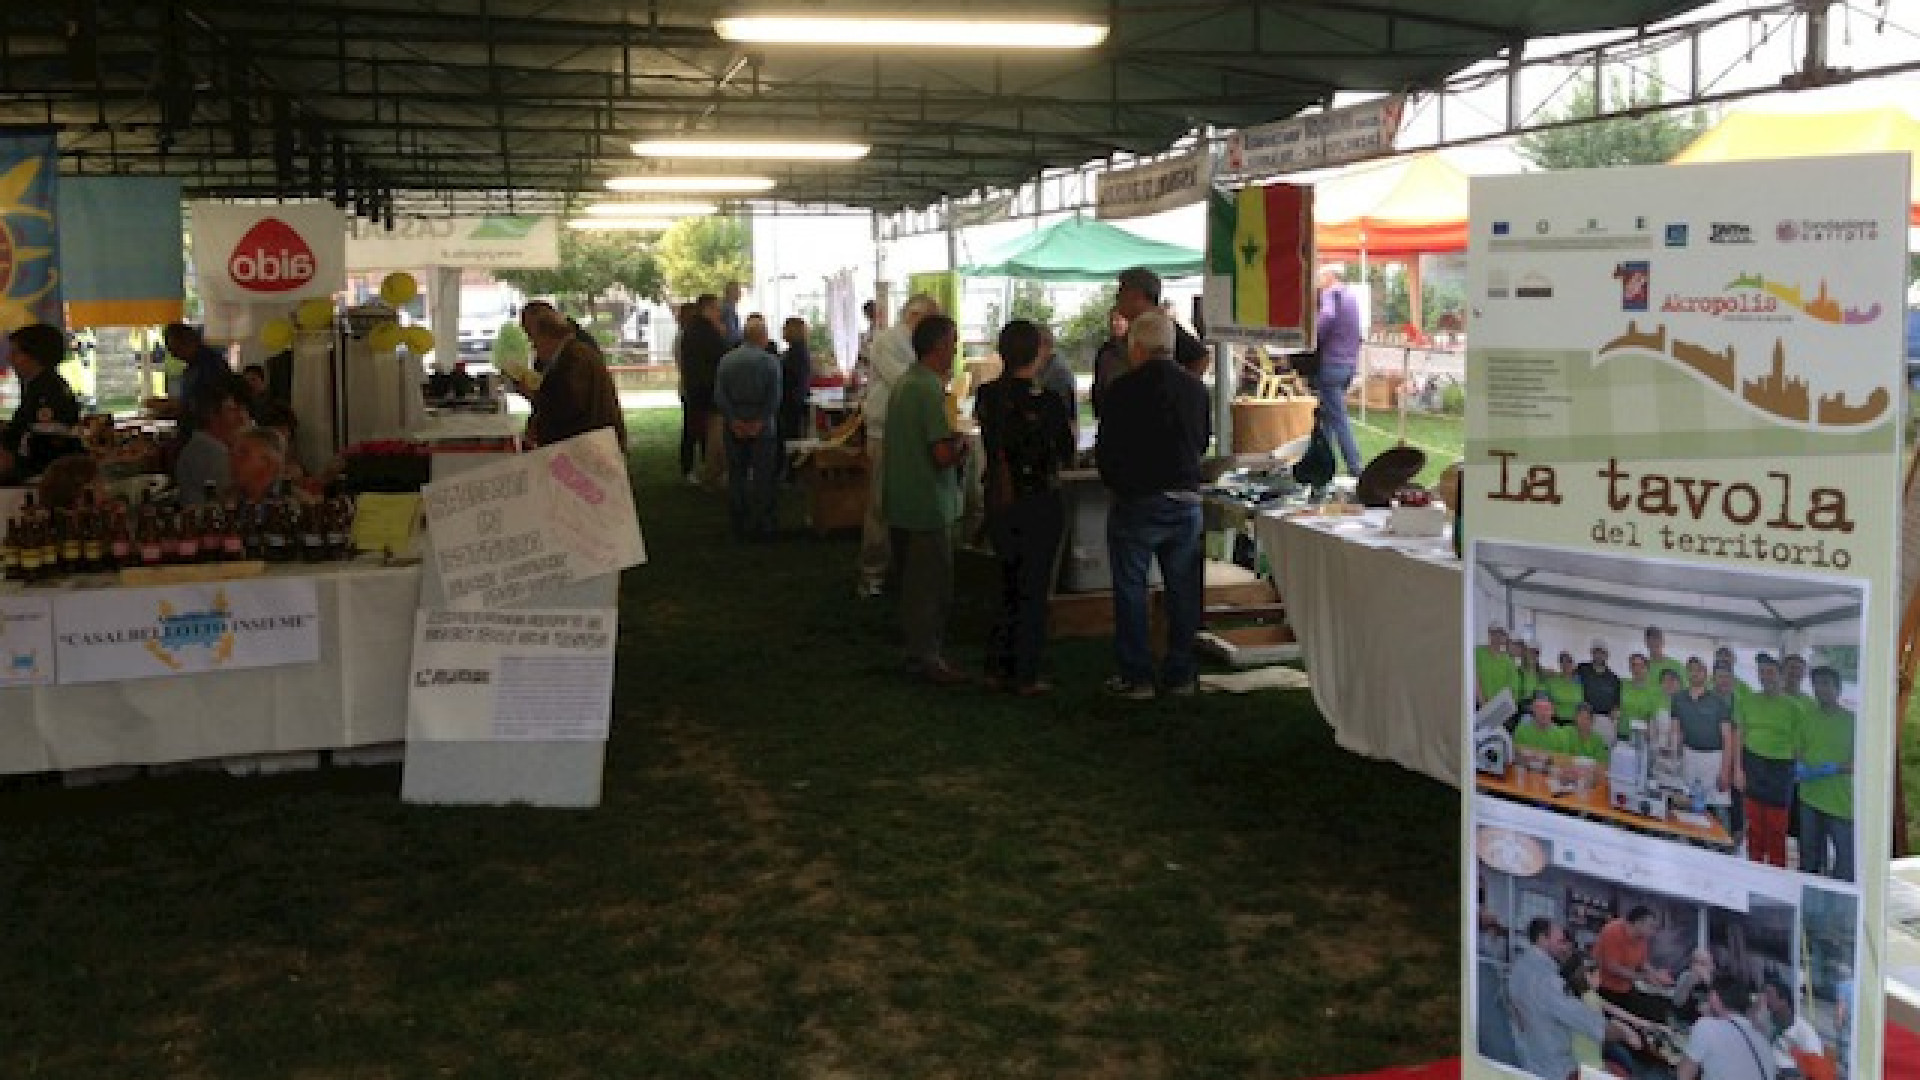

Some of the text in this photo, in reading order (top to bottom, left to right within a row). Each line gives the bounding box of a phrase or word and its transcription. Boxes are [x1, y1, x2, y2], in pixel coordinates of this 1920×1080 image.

[1660, 293, 1777, 316] Akropolis
[1487, 449, 1855, 534] La tavola
[1590, 518, 1852, 569] del territorio
